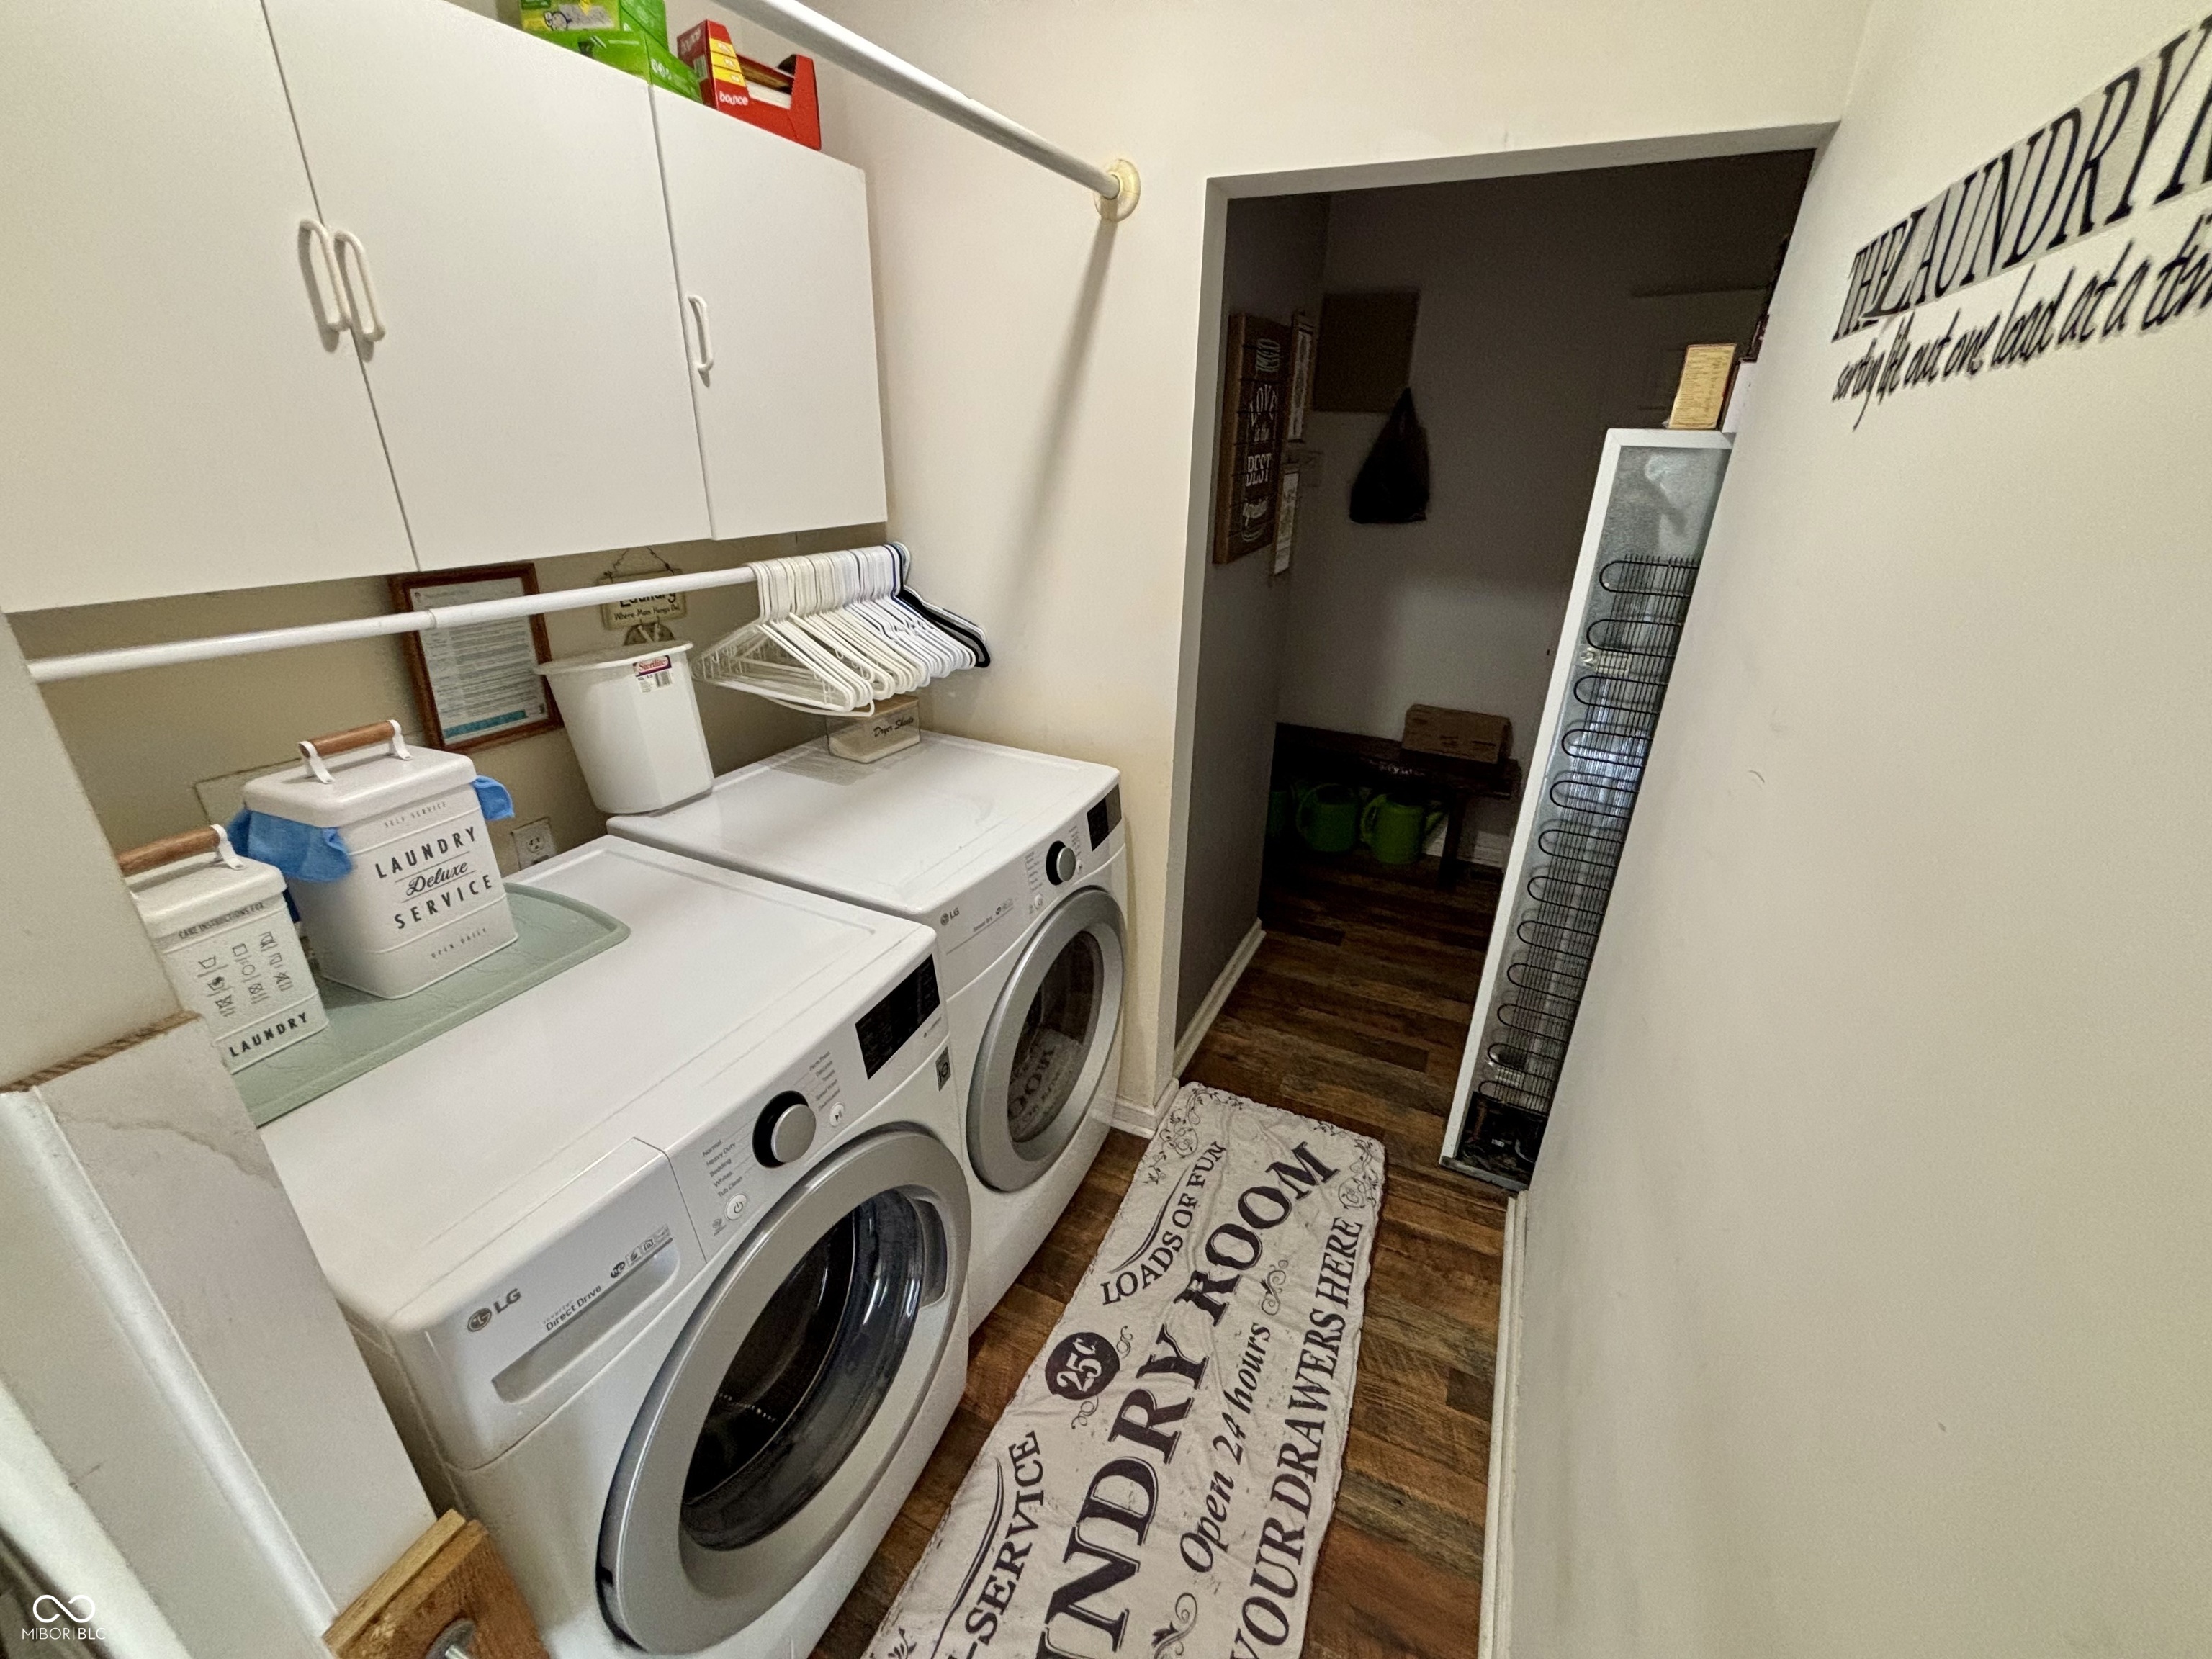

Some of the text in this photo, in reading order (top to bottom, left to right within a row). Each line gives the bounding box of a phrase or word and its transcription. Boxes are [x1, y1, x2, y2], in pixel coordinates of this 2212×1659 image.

[719, 91, 749, 107] bounce
[1861, 13, 2212, 319] LAUNDRY
[1245, 452, 1272, 487] BEST
[410, 801, 447, 819] SERVICE
[374, 826, 475, 879] LAUNDRY
[394, 874, 492, 929] SERVICE
[405, 861, 469, 896] Deluxe
[949, 907, 960, 920] LG
[229, 1012, 307, 1057] LAUNDRY
[1100, 1141, 1226, 1305] LOADS OF FUN
[493, 1287, 521, 1313] LG
[546, 1285, 602, 1331] Direct Drive
[1270, 1308, 1347, 1520] DRAWERS
[1316, 1217, 1363, 1309] HERE
[1035, 1141, 1339, 1659] NDRY ROOM
[1181, 1322, 1271, 1574] Open 24 hours
